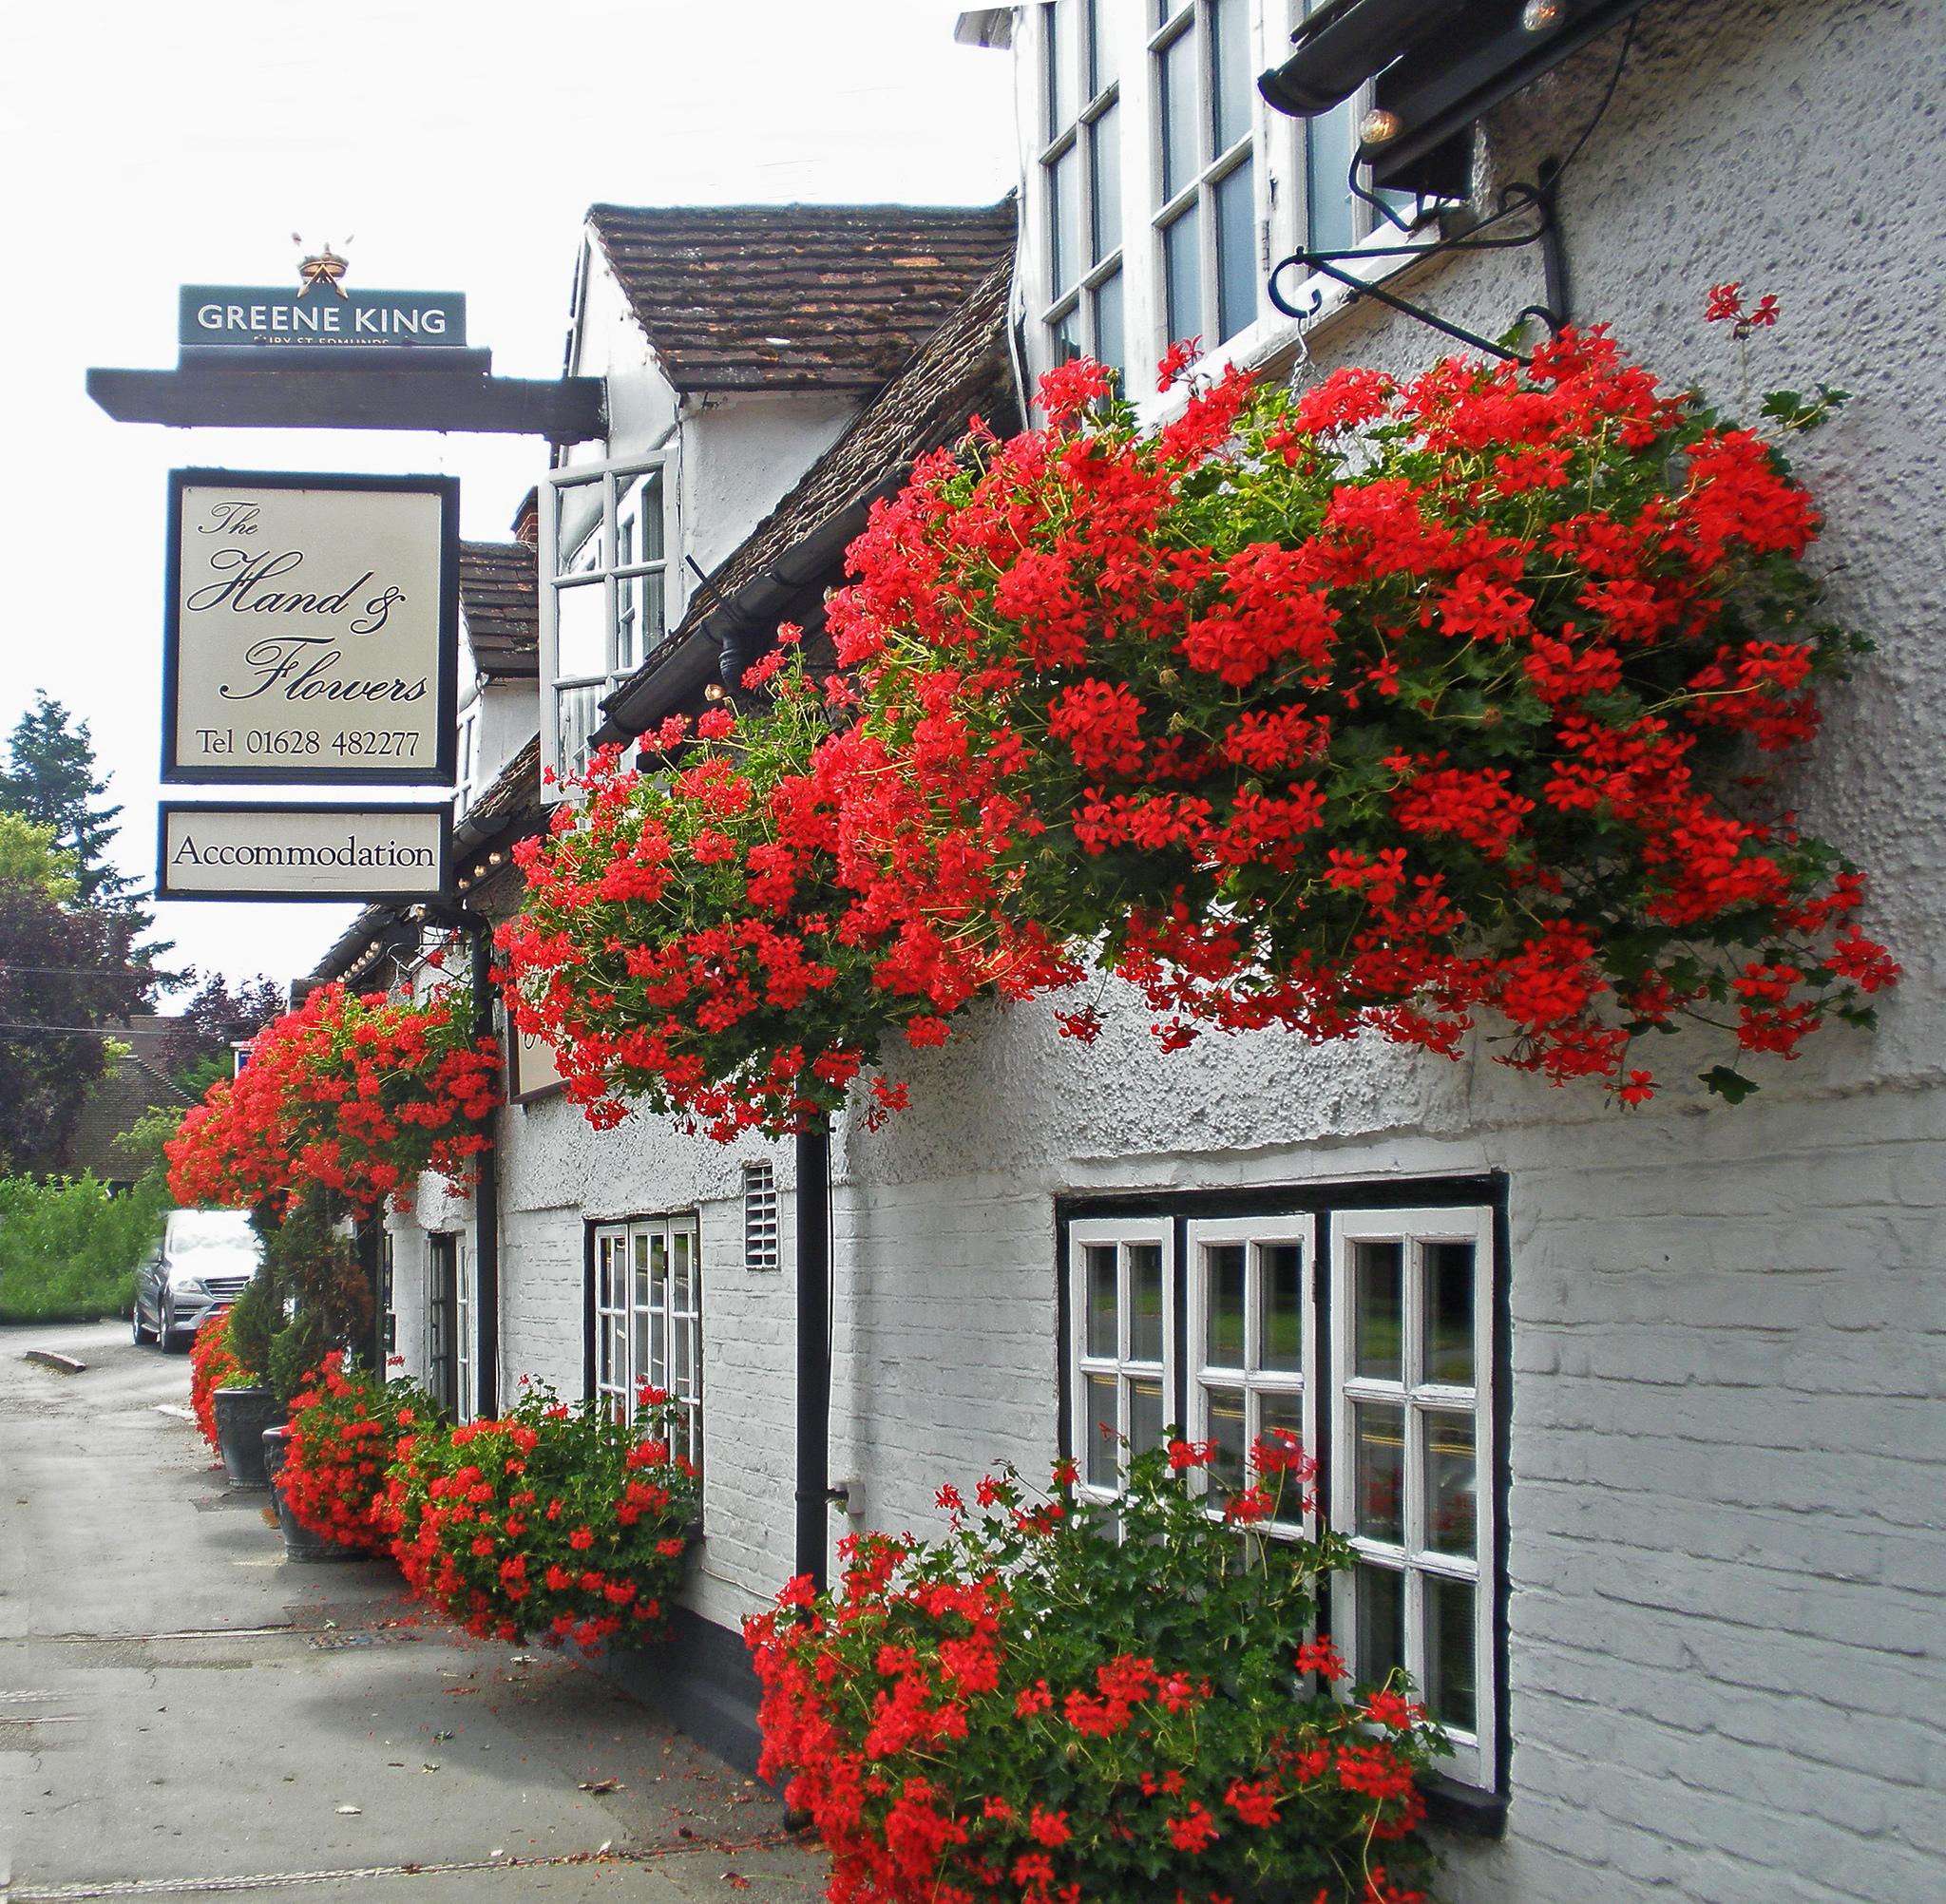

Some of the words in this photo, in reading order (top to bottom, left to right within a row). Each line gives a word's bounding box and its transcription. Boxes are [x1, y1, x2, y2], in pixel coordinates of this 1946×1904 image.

[198, 304, 340, 332] GREENE
[355, 308, 446, 333] KING
[198, 501, 261, 535] The
[187, 548, 374, 614] Hand
[350, 585, 407, 635] &
[219, 636, 428, 702] Flowers
[196, 729, 234, 753] Tel
[246, 730, 320, 754] 01628
[332, 731, 419, 756] 482277
[171, 835, 436, 866] Accommodation
